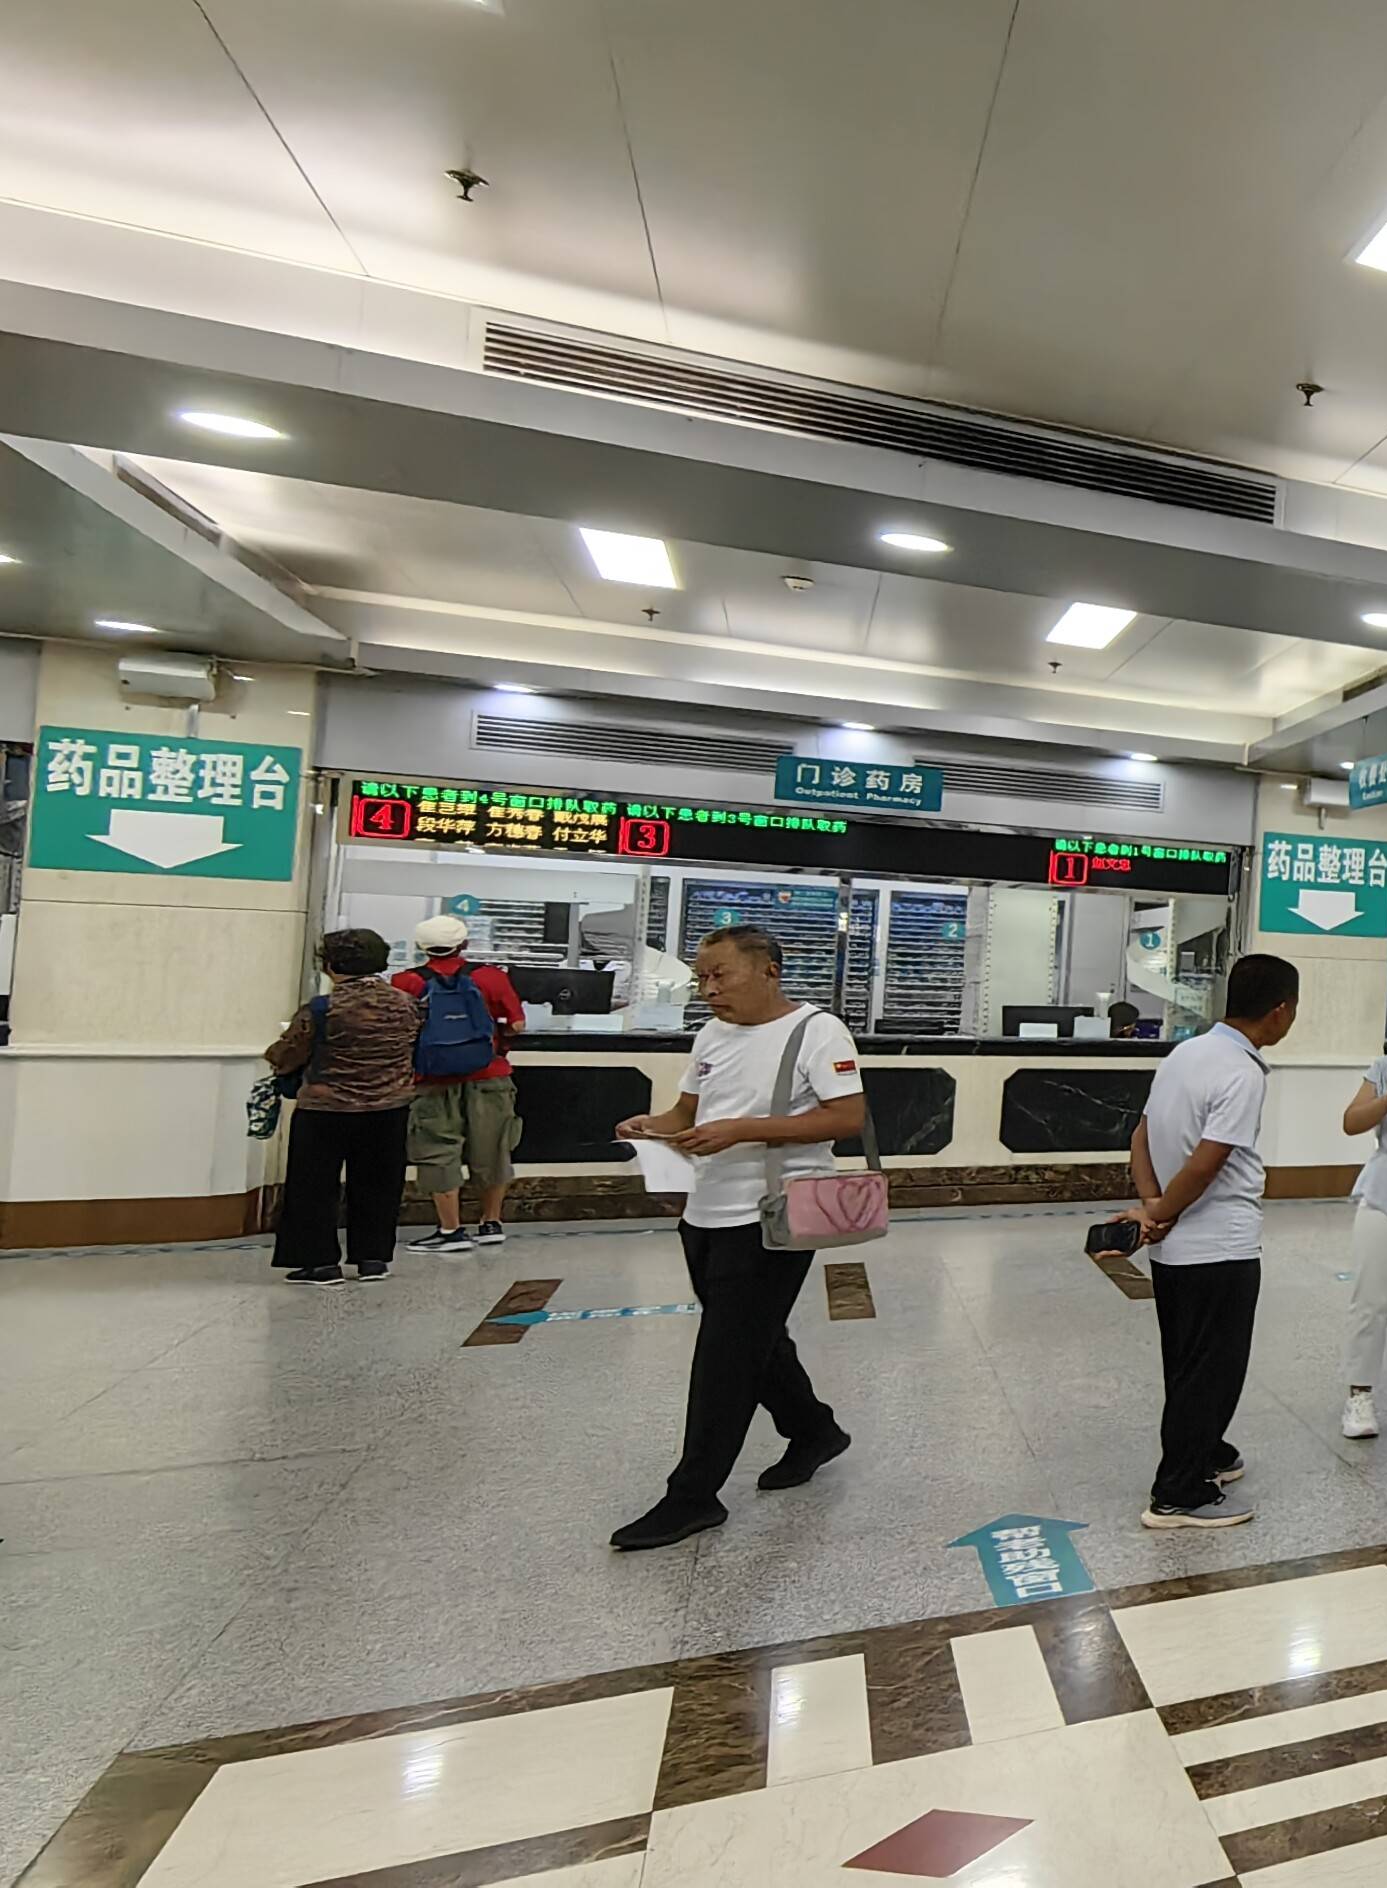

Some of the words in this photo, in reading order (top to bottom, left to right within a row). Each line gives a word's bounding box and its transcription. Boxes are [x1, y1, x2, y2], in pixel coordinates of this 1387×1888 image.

[46, 738, 290, 810] 药品整理台
[797, 763, 923, 794] 门诊药房
[361, 781, 617, 815] 请以下患者到4号窗口排队取药
[795, 786, 859, 799] Outpatient
[866, 792, 922, 806] Pharmacy
[369, 804, 393, 830] 4
[552, 826, 608, 845] 付立华
[637, 825, 656, 850] 3
[1267, 840, 1387, 888] 药品整理台
[721, 911, 732, 925] 3
[948, 925, 958, 938] 2
